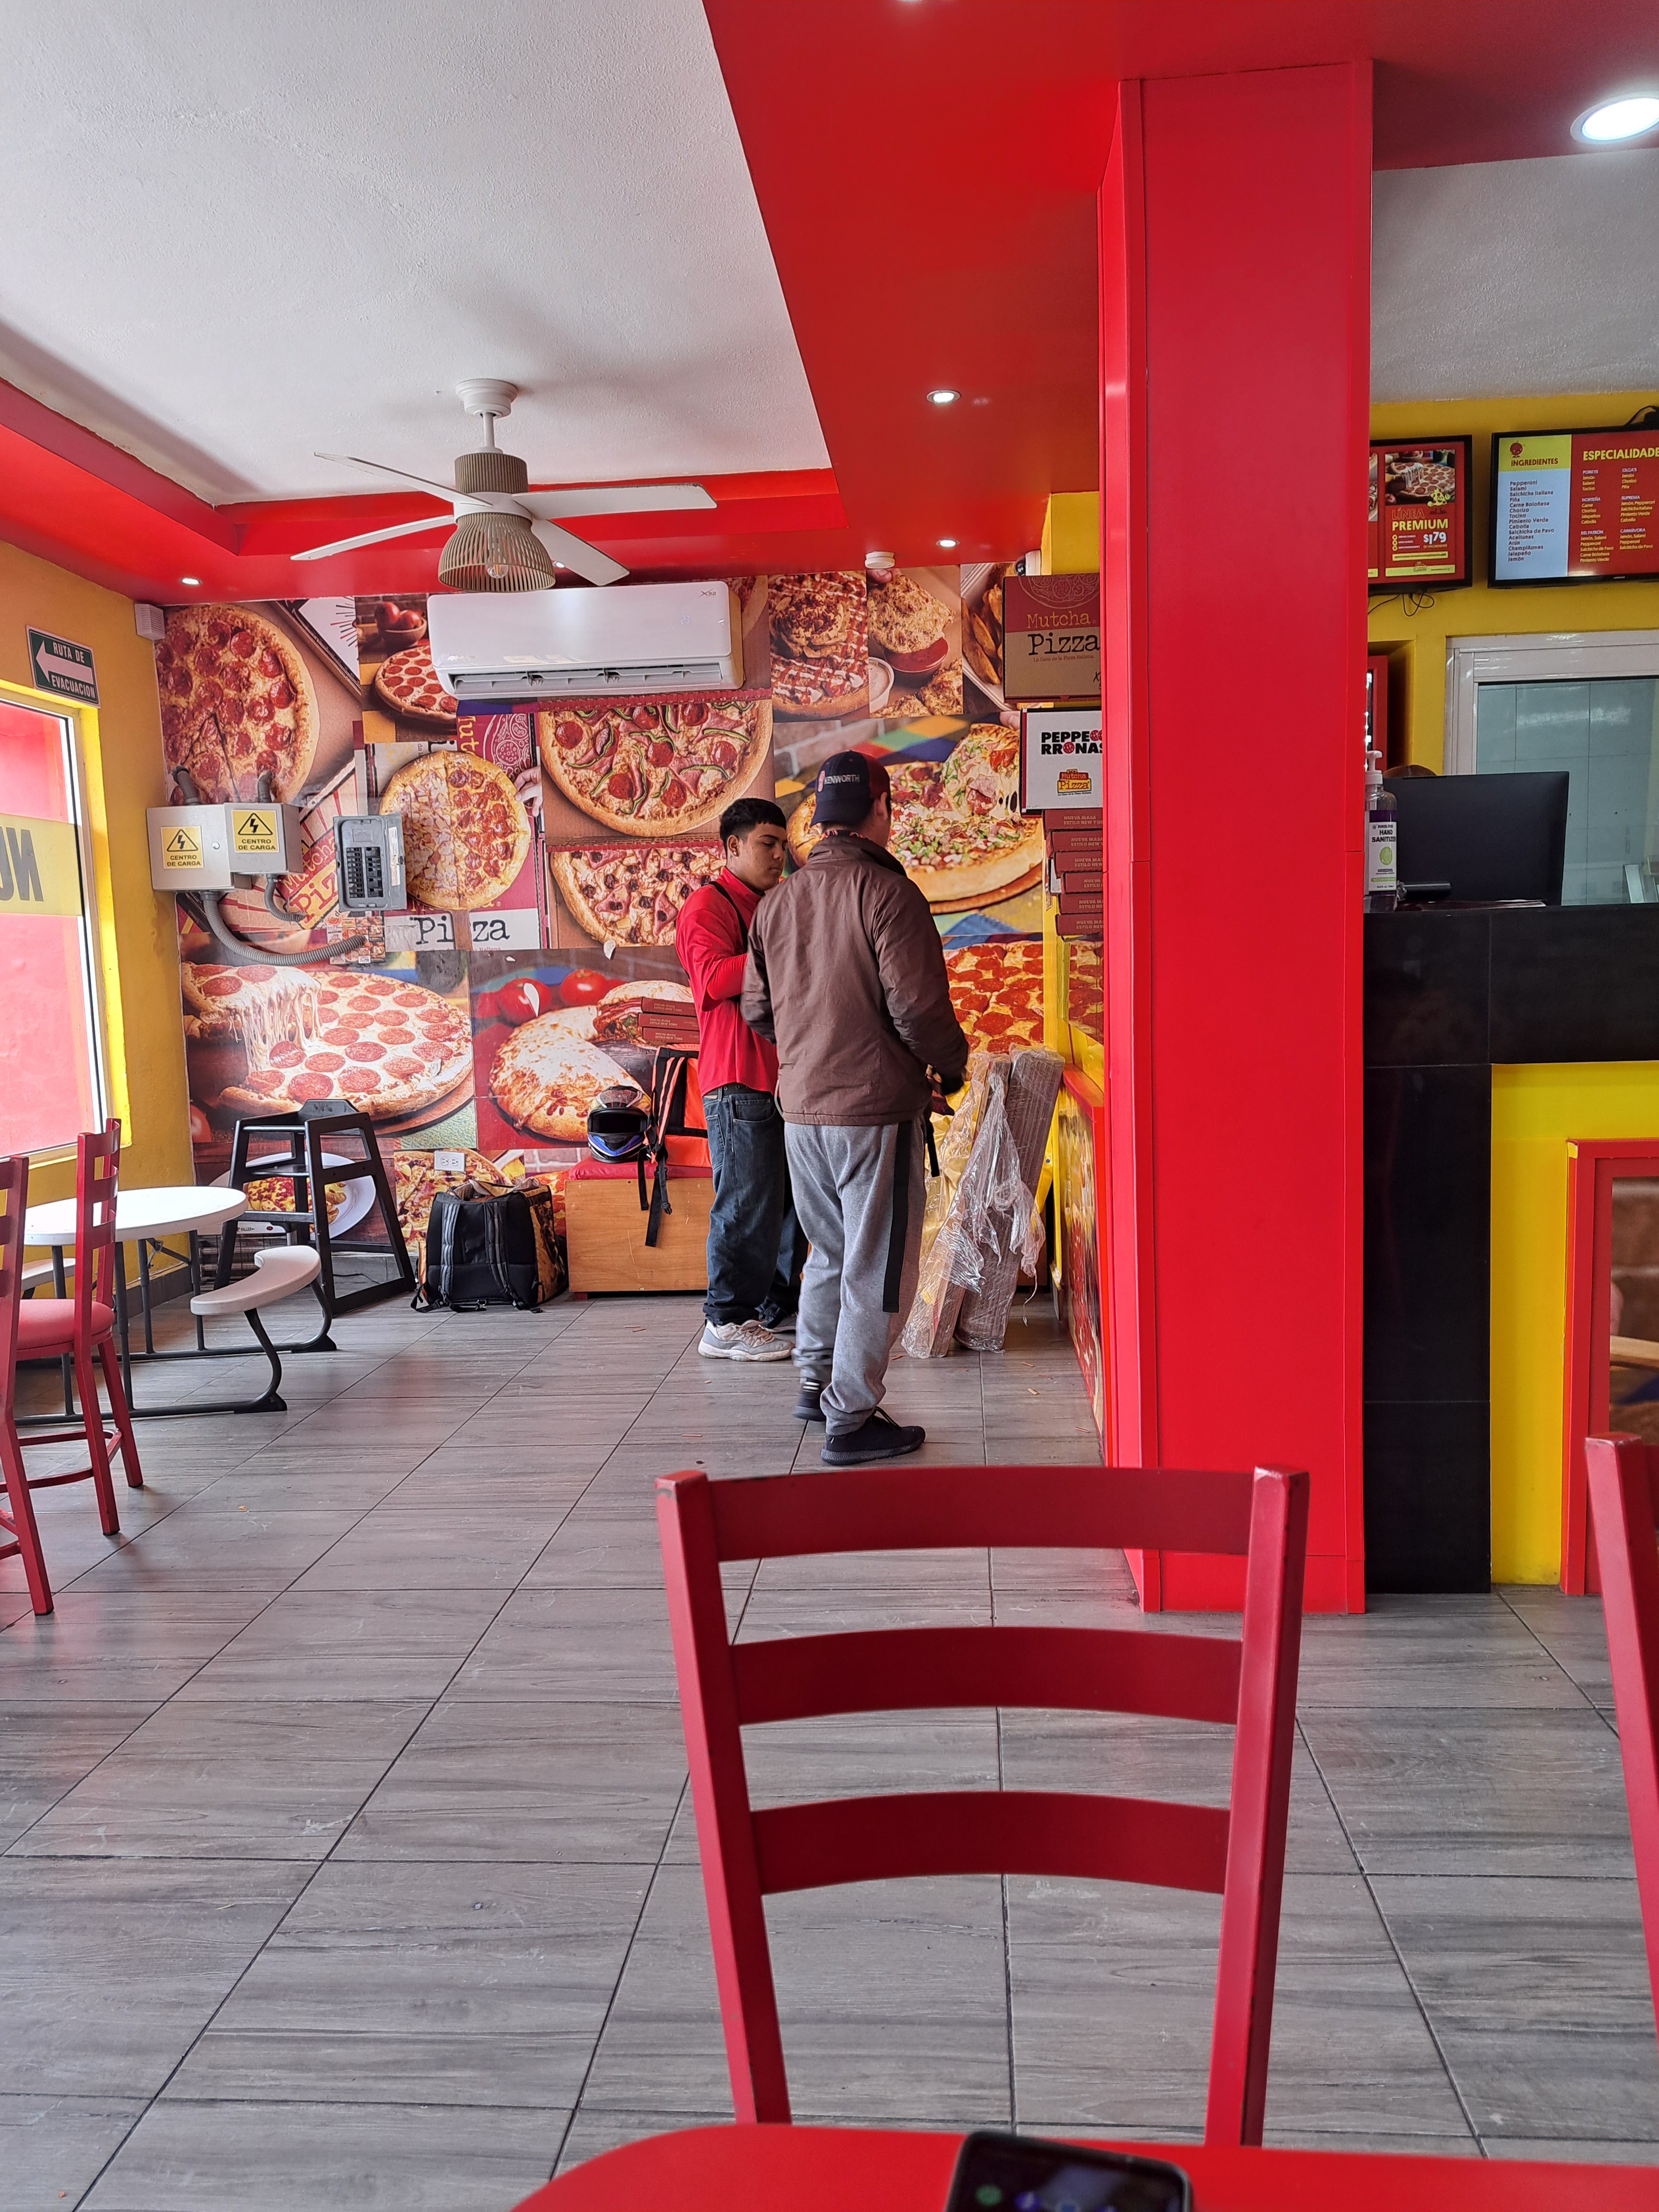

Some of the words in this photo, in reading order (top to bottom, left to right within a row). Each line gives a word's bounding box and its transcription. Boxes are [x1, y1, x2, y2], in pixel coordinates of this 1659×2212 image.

[1511, 458, 1559, 466] INGREDIENTES
[1510, 480, 1537, 488] Pepperoni
[1392, 507, 1425, 520] LÍNEA
[1392, 519, 1449, 531] PREMIUM
[1423, 531, 1447, 545] $179
[1027, 611, 1091, 628] Mutcha
[1028, 632, 1100, 655] Pizza
[53, 641, 72, 659] RUTA
[75, 649, 85, 663] DE
[51, 674, 95, 698] EVACUACION
[1059, 780, 1089, 790] Pizza
